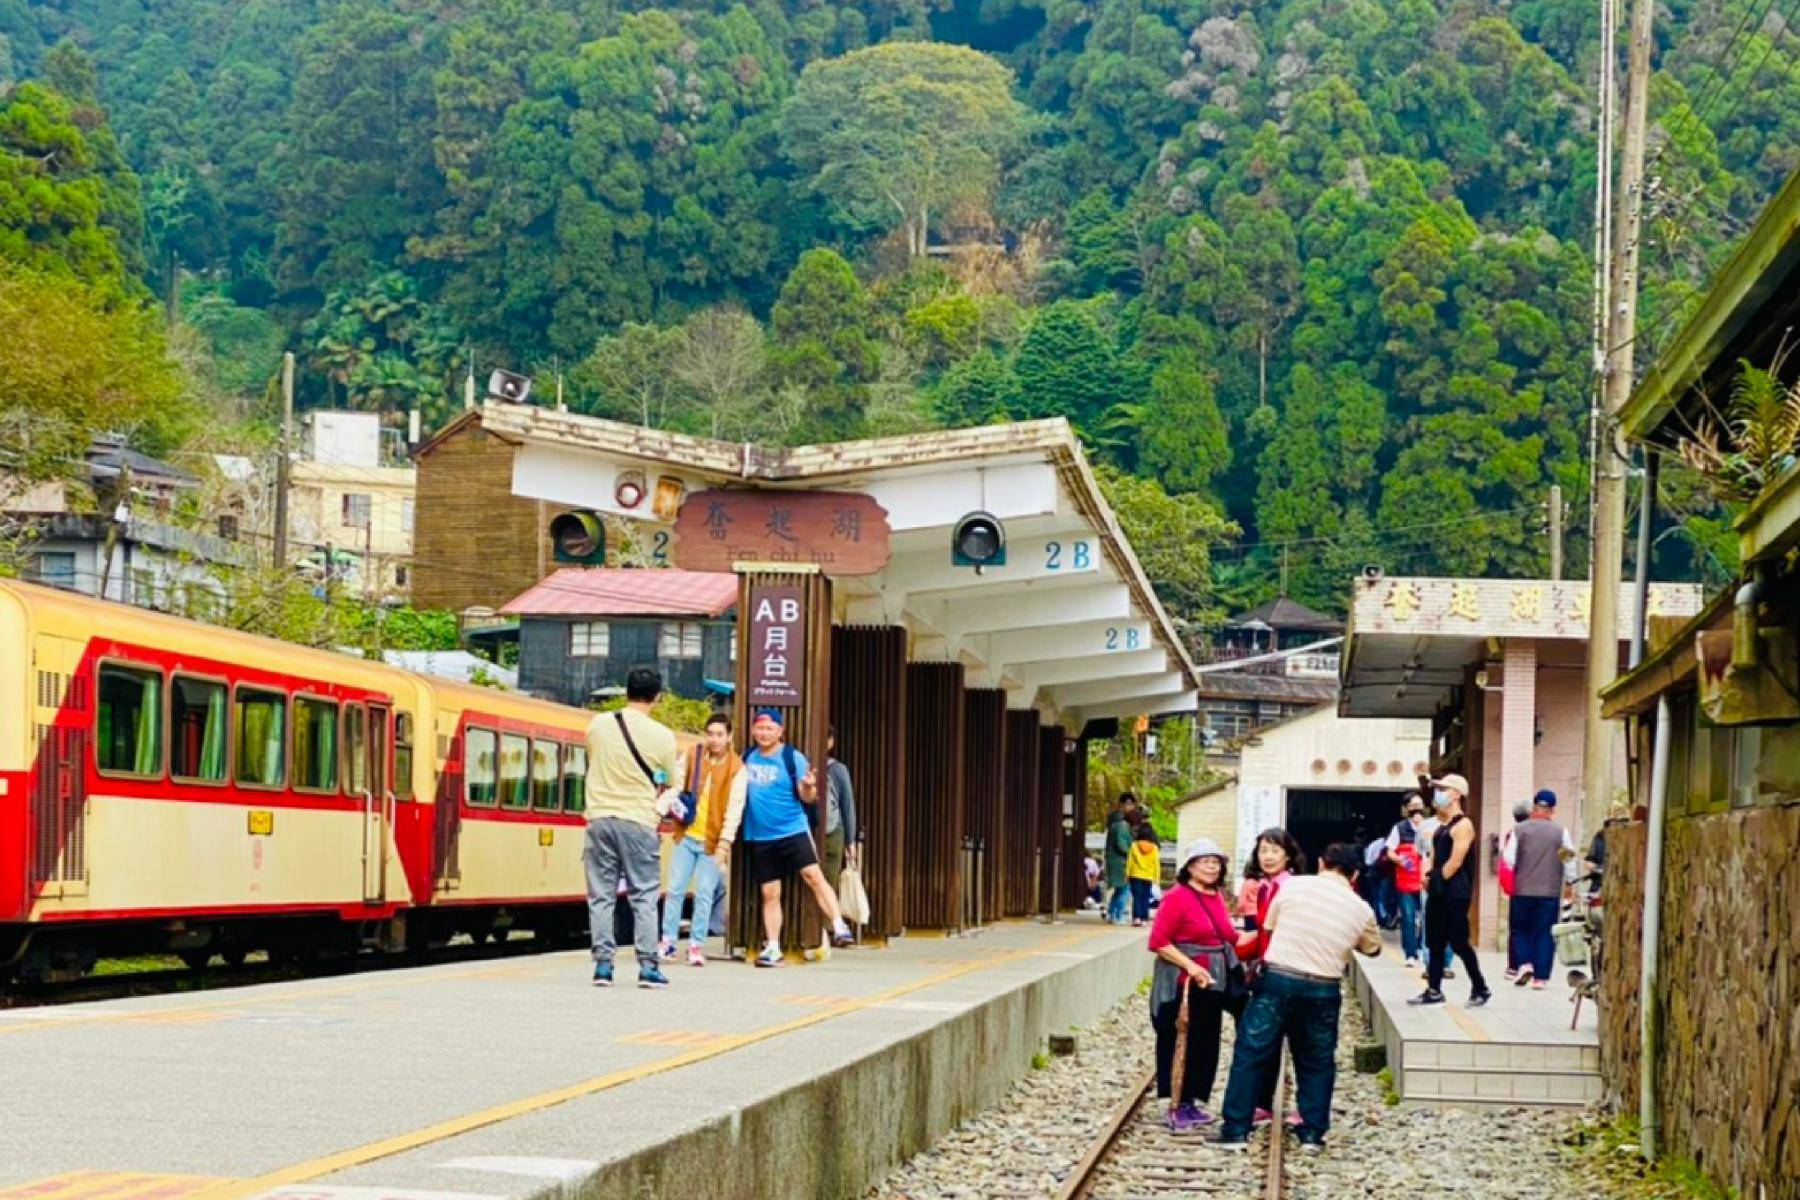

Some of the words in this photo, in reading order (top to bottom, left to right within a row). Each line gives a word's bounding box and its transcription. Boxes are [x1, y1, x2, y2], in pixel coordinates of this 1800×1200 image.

[653, 531, 669, 558] 2
[755, 598, 799, 622] AB
[764, 626, 787, 677] 月台
